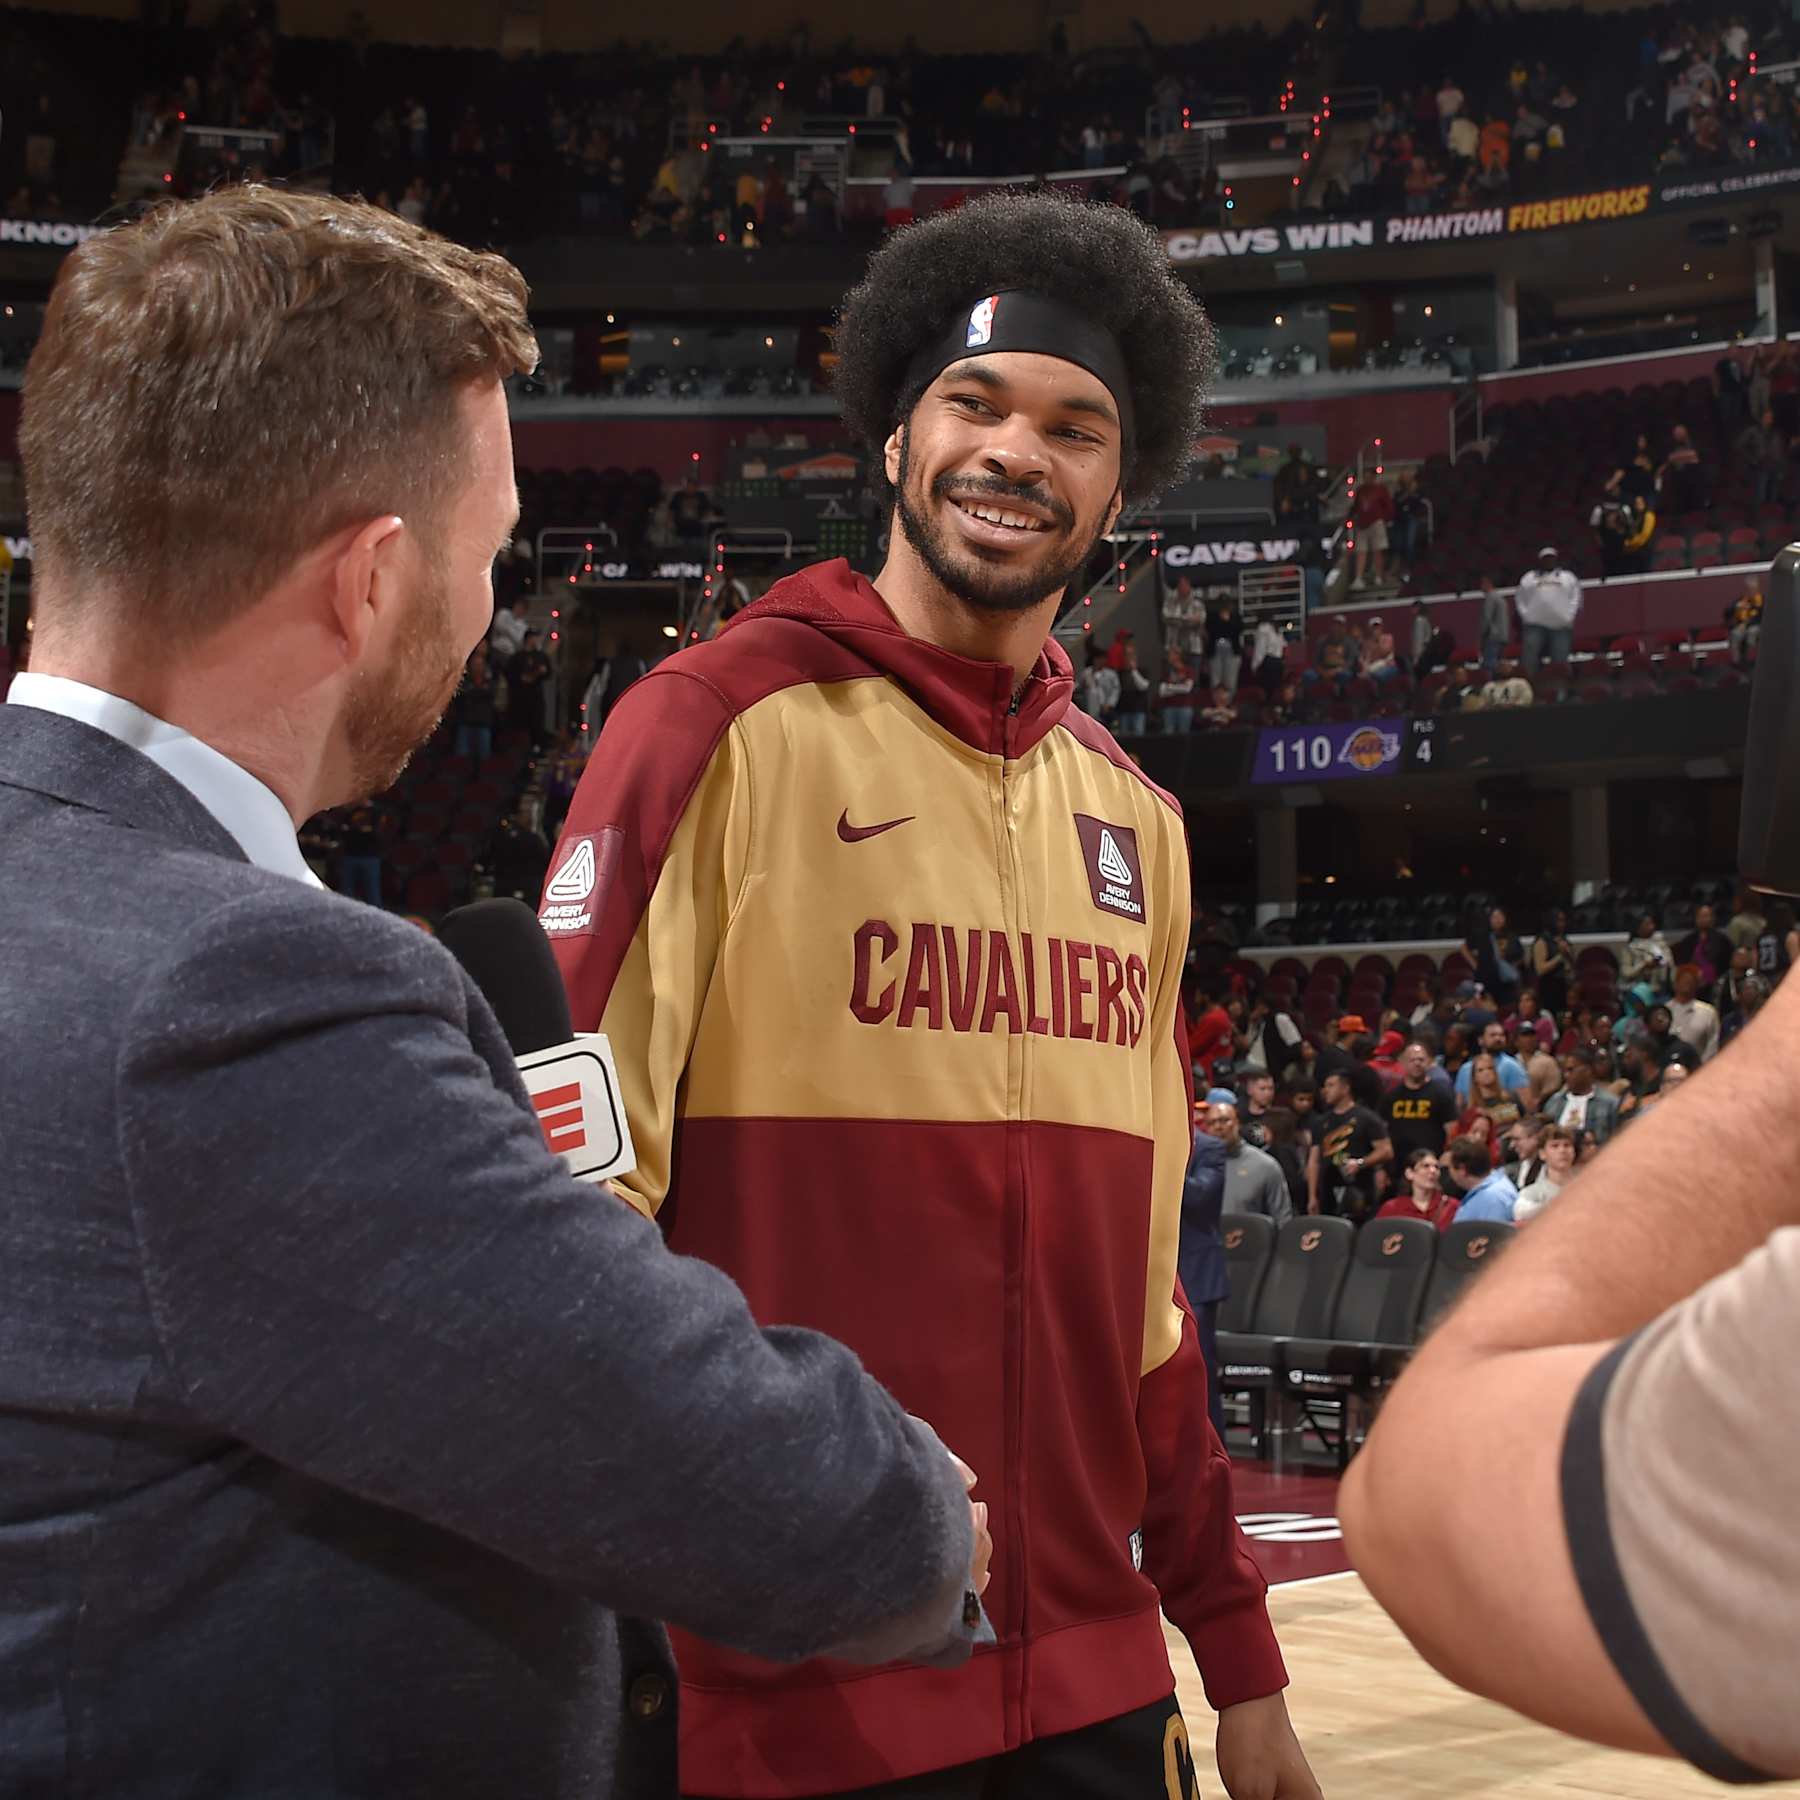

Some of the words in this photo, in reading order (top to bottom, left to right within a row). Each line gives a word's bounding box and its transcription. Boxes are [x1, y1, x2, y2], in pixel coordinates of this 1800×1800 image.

[1661, 181, 1718, 201] OFFICIAL
[1386, 209, 1503, 243] PHANTOM
[1508, 185, 1650, 232] FIREWORKS
[1167, 227, 1280, 260] CAVS
[1286, 220, 1373, 250] WIN
[1165, 541, 1257, 567] CAVS
[1270, 735, 1332, 772] 110
[1416, 739, 1432, 762] 4
[1106, 883, 1131, 900] AVERY
[542, 903, 586, 918] AVERY
[1098, 892, 1142, 914] DENNISON
[538, 913, 591, 931] ENNISON
[850, 919, 1147, 1049] CAVALIERS
[1392, 1100, 1432, 1119] CLE
